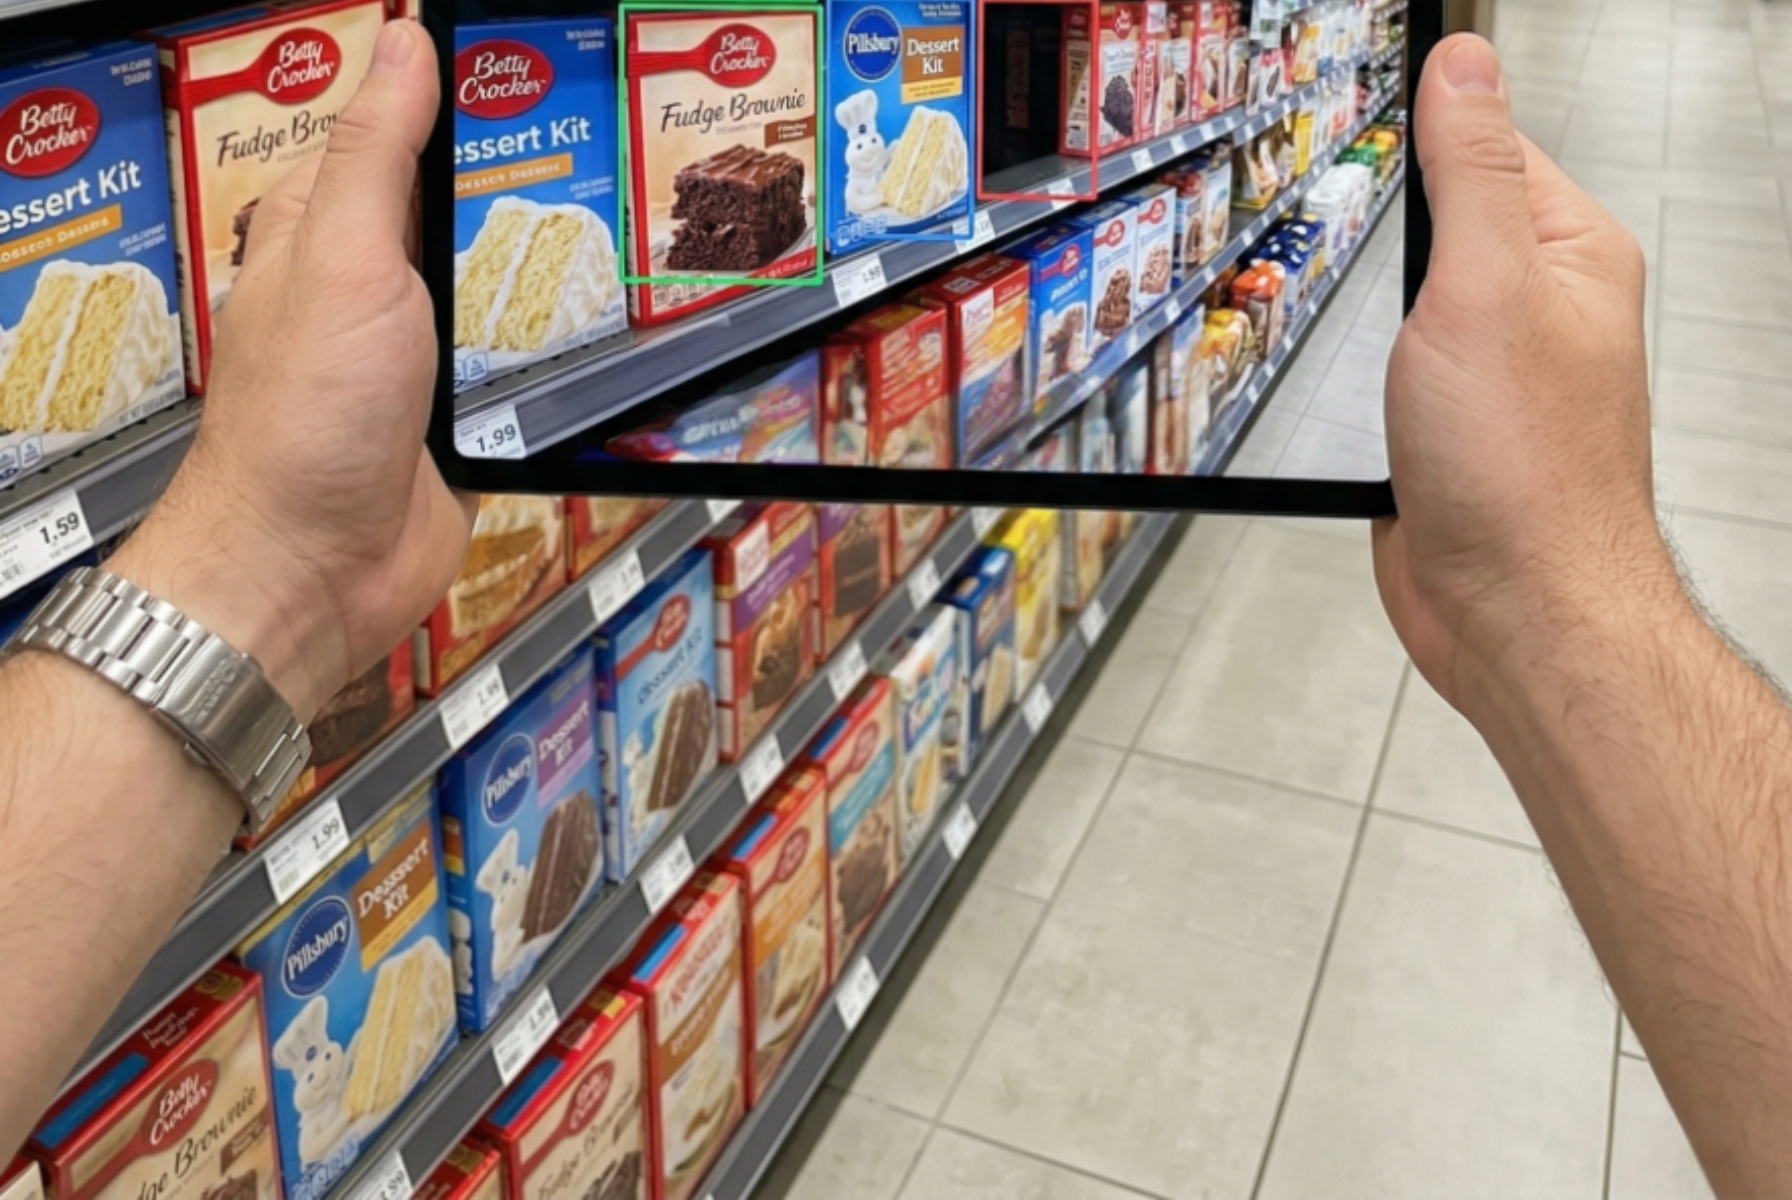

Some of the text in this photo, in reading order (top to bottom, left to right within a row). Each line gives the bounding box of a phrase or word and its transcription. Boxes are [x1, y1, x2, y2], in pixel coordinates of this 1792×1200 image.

[279, 39, 323, 69] Betty
[720, 33, 760, 57] Betty
[847, 32, 900, 57] Pillsbury
[906, 37, 960, 57] Dessert
[267, 61, 333, 93] Crocker
[474, 51, 532, 81] Betty
[710, 52, 769, 75] Crocker
[921, 56, 944, 76] Kit
[459, 75, 542, 105] Crocker
[20, 102, 78, 136] Betty
[660, 88, 806, 135] Fudge Brownie
[5, 122, 90, 166] Crocker
[216, 124, 287, 168] Fudge
[550, 116, 592, 147] Kit
[97, 159, 142, 199] Kit
[476, 424, 516, 453] 1.99
[40, 511, 80, 544] 1.59
[286, 915, 348, 982] Pillsbury
[173, 1086, 257, 1179] Brownie
